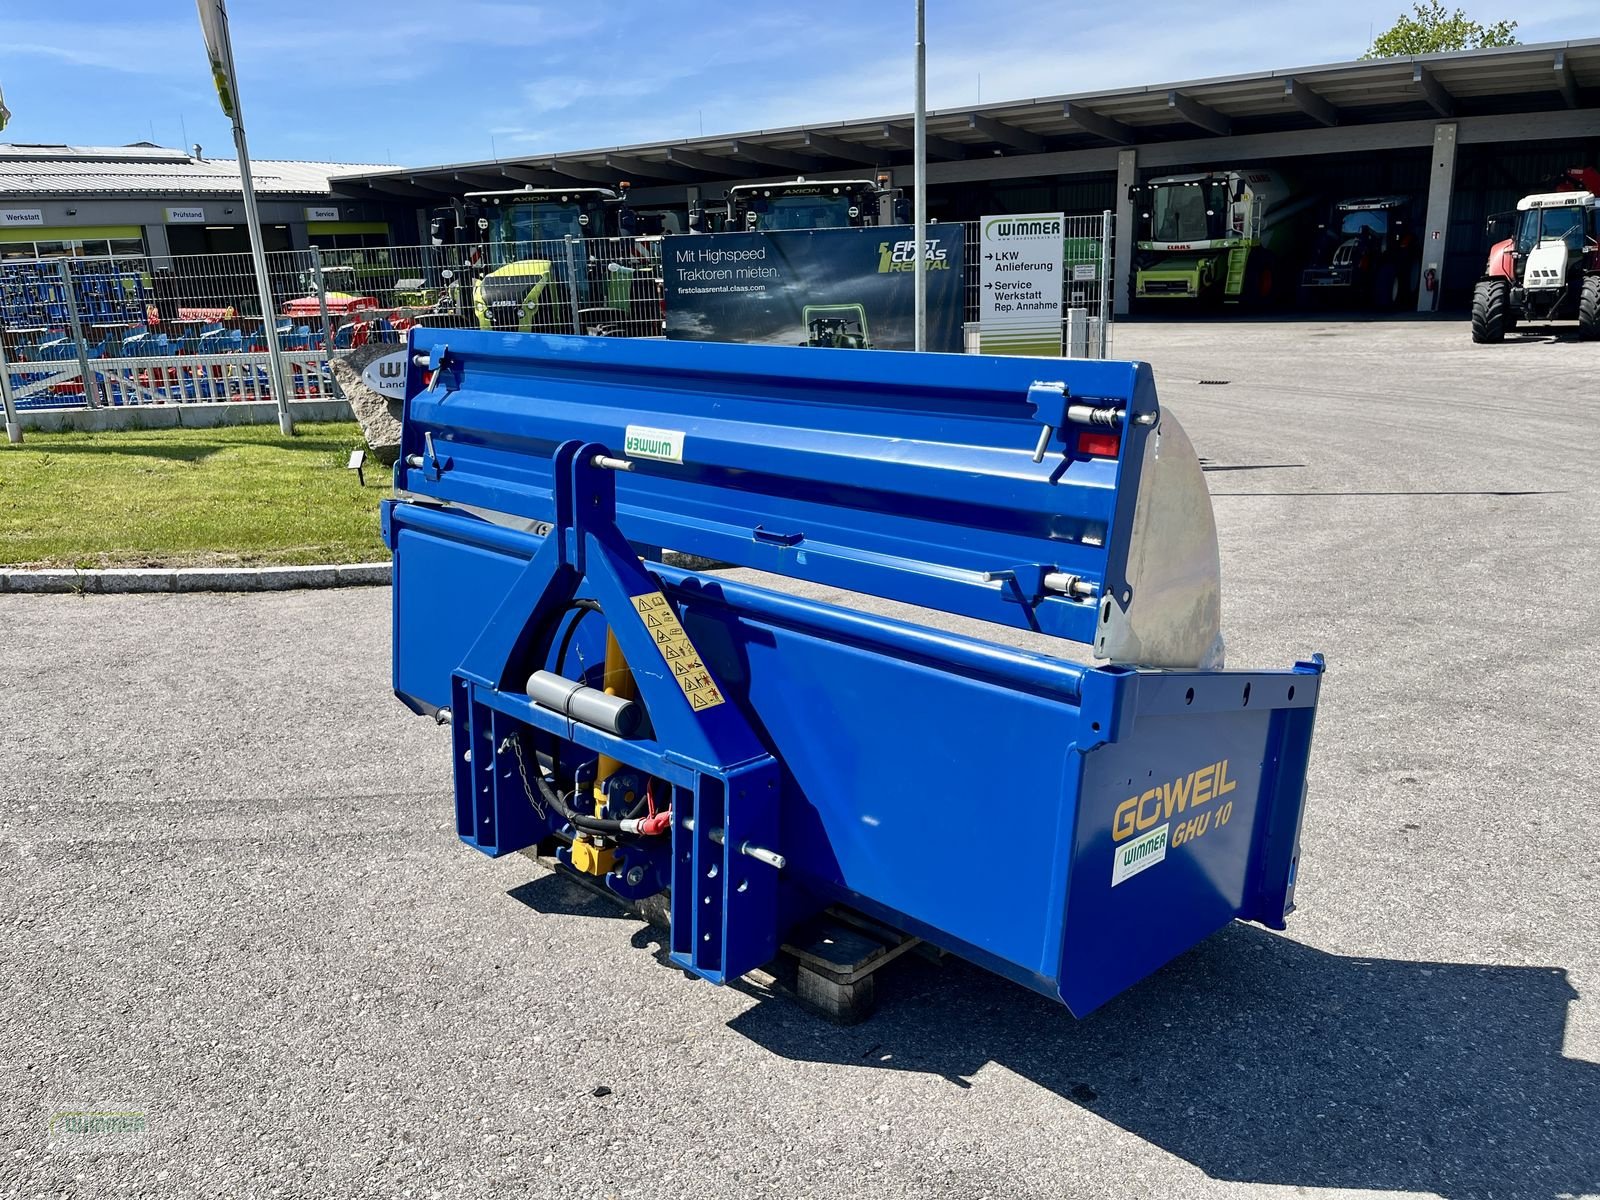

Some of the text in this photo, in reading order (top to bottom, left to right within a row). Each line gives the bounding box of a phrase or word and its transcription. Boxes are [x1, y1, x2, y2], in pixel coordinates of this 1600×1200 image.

[998, 222, 1060, 236] WIMMER
[676, 246, 766, 264] Mit Highspeed
[995, 251, 1020, 261] LKW
[676, 266, 781, 281] Traktoren mieten.
[995, 262, 1053, 272] Anlieferung
[677, 284, 766, 294] firstclaasrental.claas.com
[994, 281, 1032, 290] Service
[994, 291, 1042, 301] Werkstatt
[994, 301, 1058, 313] Rep. Annahme
[626, 436, 672, 457] WIMMER
[1171, 801, 1233, 849] GHU 10
[1123, 832, 1167, 867] WIMMER
